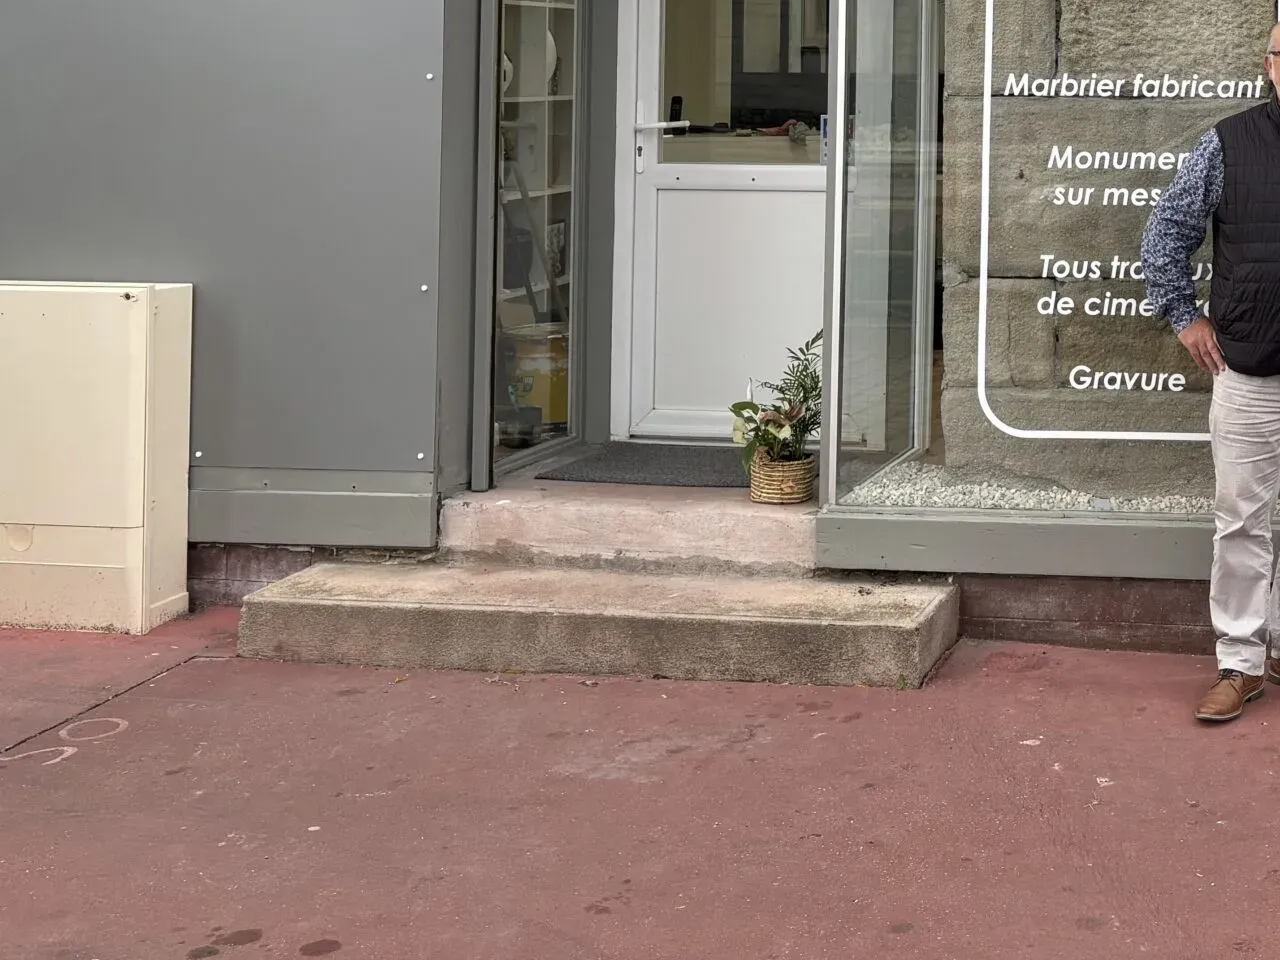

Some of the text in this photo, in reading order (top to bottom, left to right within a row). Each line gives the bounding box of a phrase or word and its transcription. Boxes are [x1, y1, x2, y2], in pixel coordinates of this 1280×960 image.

[1003, 73, 1264, 99] Marbrier fabricant
[1053, 187, 1161, 207] sur mes
[1039, 254, 1101, 280] Tous
[1036, 292, 1075, 316] de
[1068, 364, 1187, 392] Gravure
